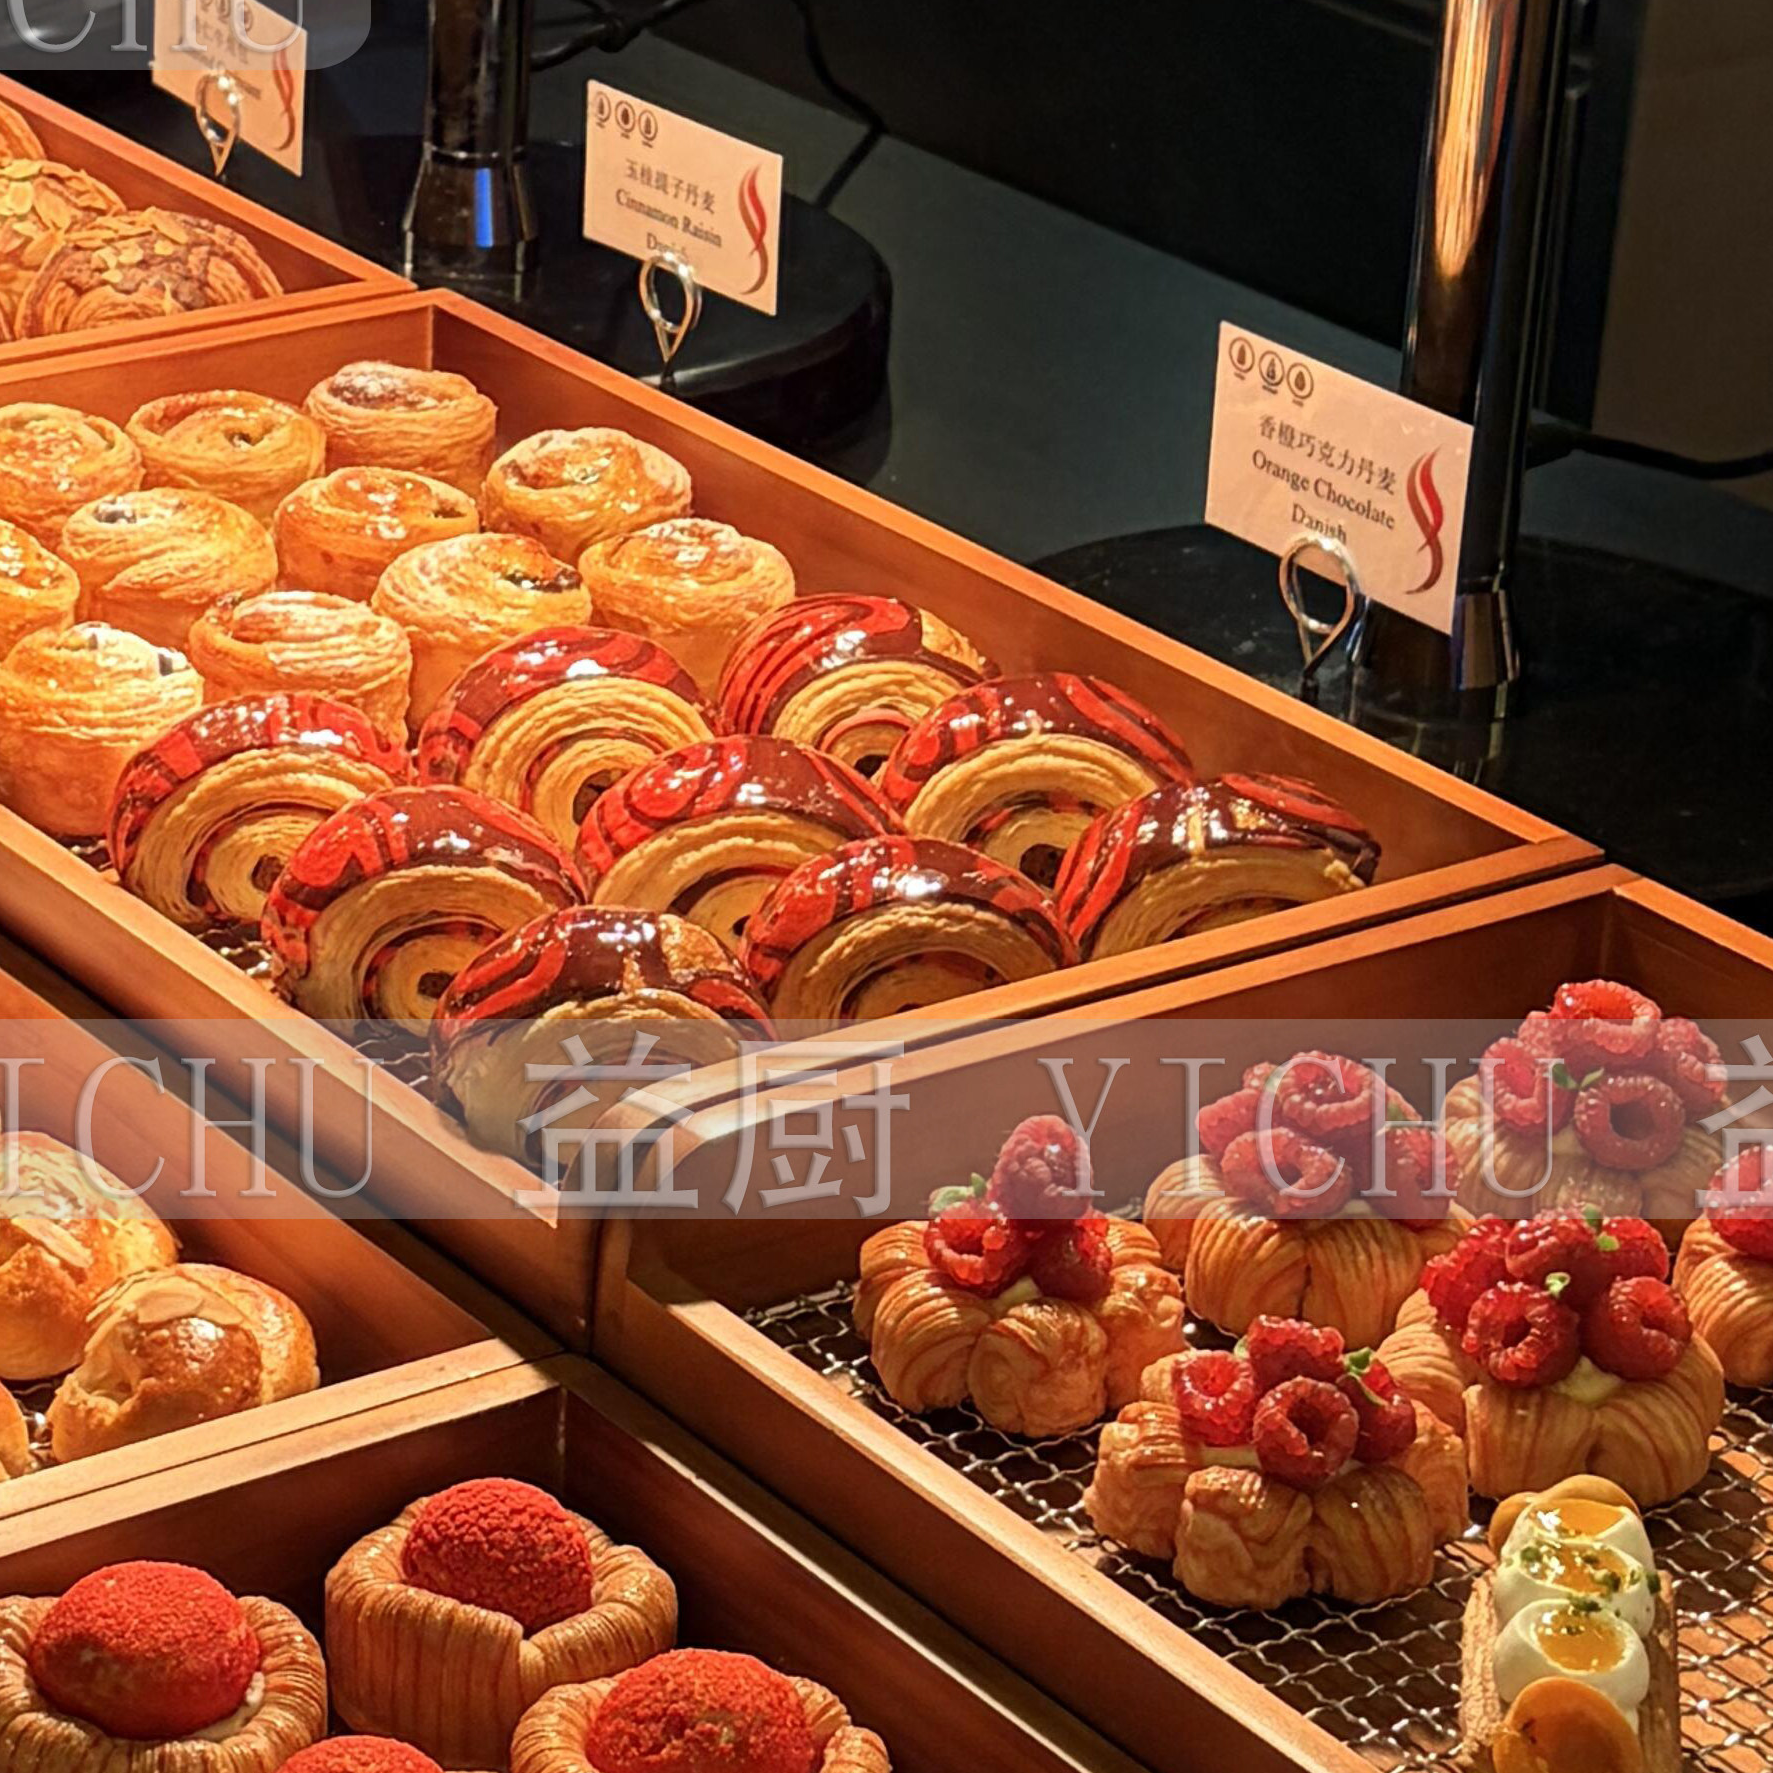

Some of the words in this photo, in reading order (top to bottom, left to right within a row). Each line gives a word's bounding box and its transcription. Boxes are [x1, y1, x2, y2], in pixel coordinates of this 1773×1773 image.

[615, 187, 679, 230] Cinnamon
[681, 214, 723, 248] Raisin
[1251, 449, 1310, 492] Orange
[1313, 476, 1396, 530] Chocolate
[1259, 413, 1397, 496] 香橙巧克力丹麦
[1291, 502, 1348, 546] Danish
